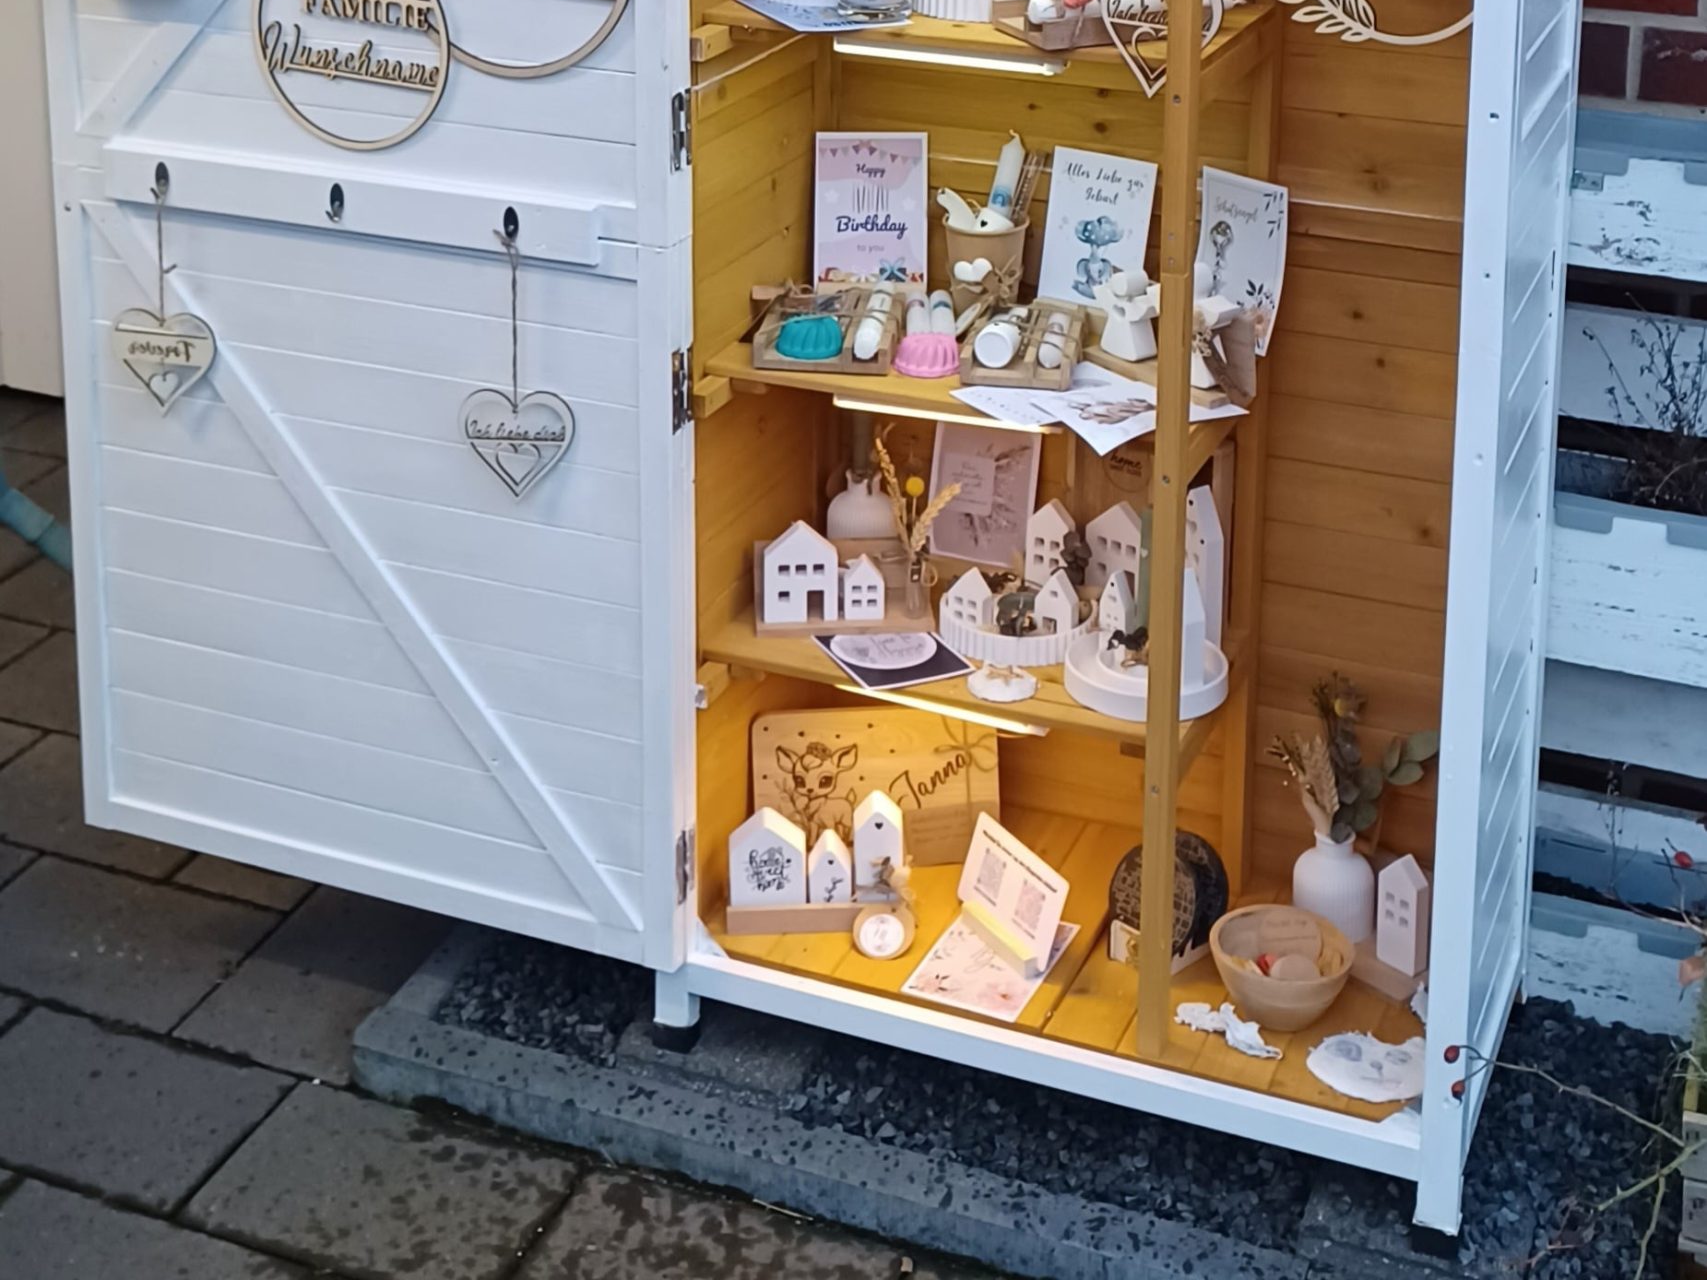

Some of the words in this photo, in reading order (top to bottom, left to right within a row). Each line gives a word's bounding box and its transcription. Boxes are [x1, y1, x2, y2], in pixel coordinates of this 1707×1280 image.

[263, 20, 441, 88] Wunschname
[855, 163, 886, 179] Happy
[1063, 162, 1090, 180] Alles
[1096, 168, 1122, 184] Liebe
[1085, 186, 1120, 205] Geburt
[835, 213, 908, 240] Birthday
[856, 244, 867, 253] to
[868, 244, 885, 254] you
[888, 752, 966, 810] Janna
